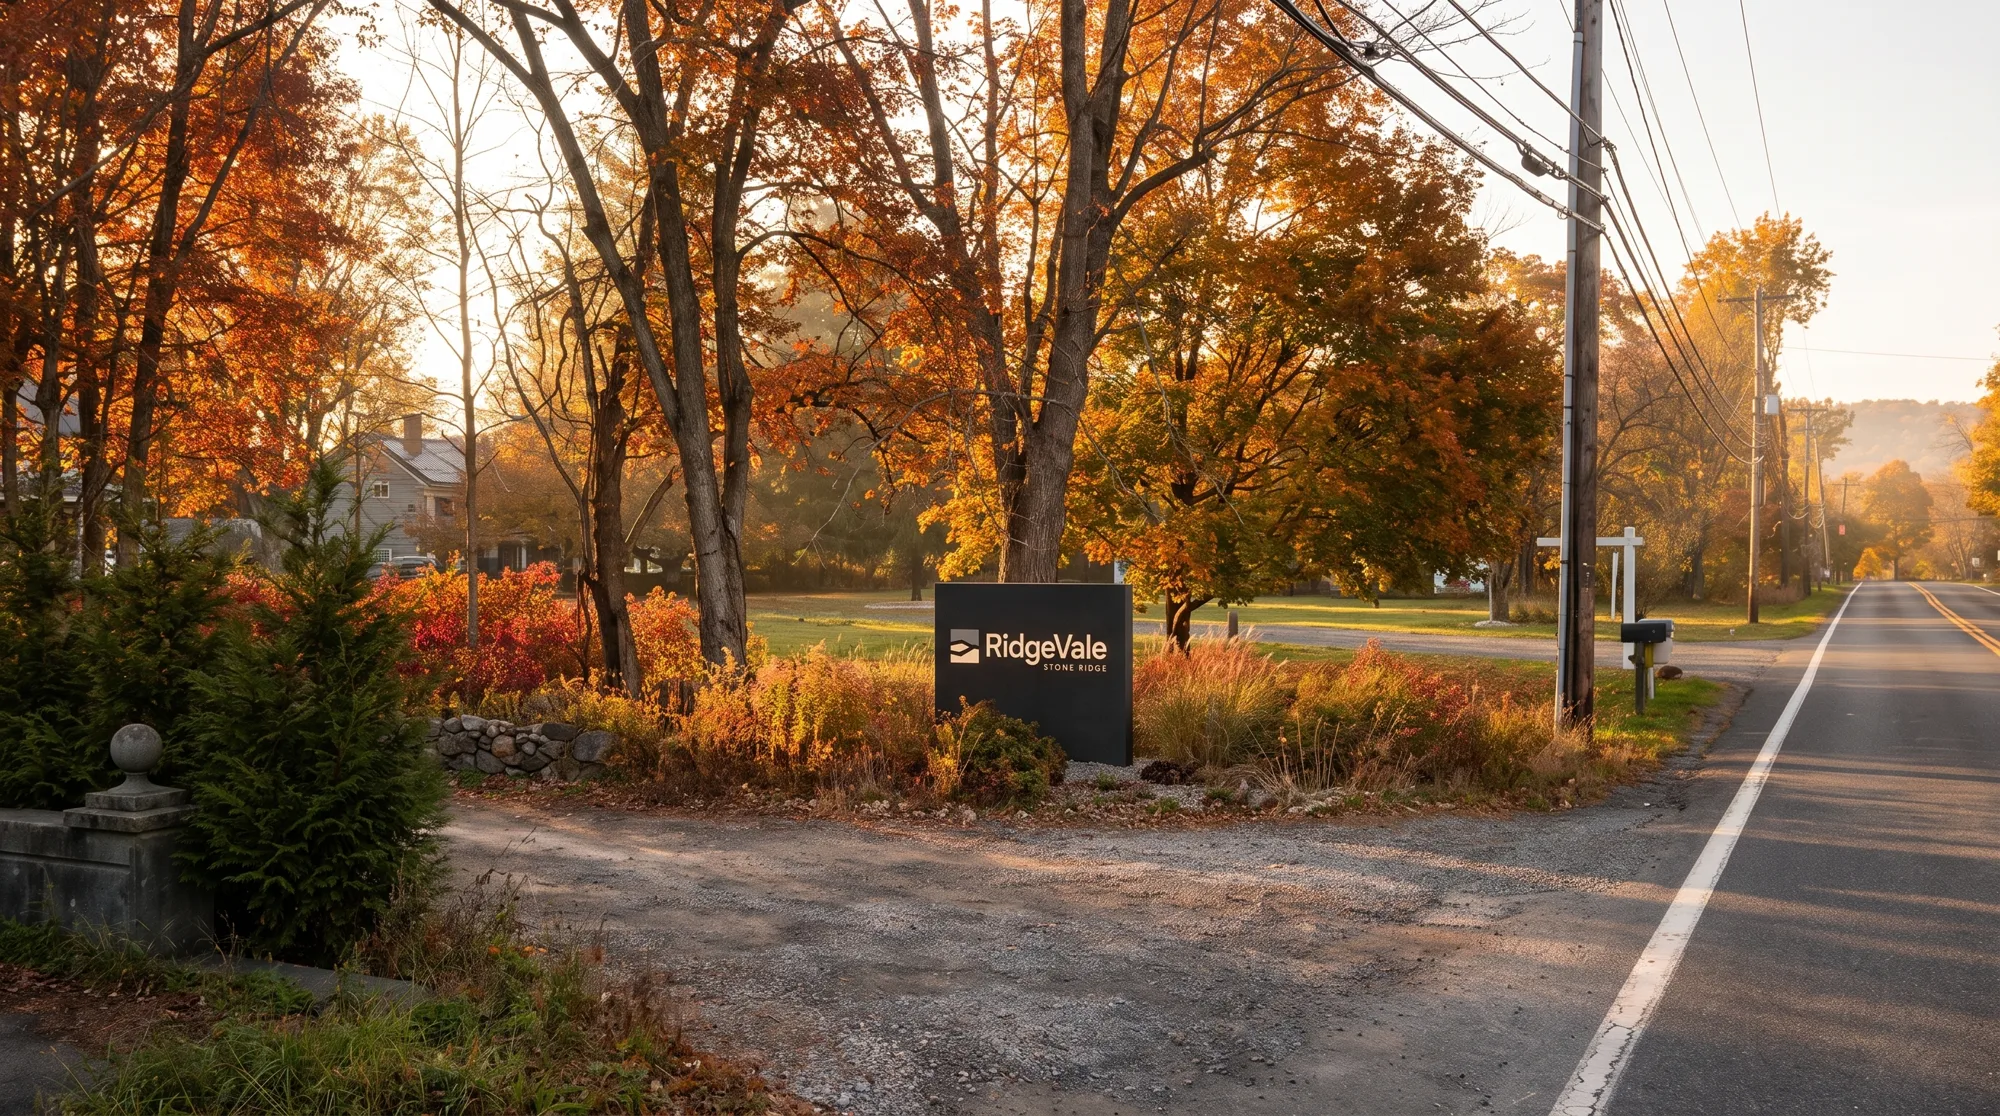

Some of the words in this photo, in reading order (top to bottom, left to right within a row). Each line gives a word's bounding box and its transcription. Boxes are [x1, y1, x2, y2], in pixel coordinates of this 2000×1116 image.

[986, 633, 1107, 666] RidgeVale
[1043, 663, 1075, 671] STONE
[1078, 664, 1107, 672] RIDGE
